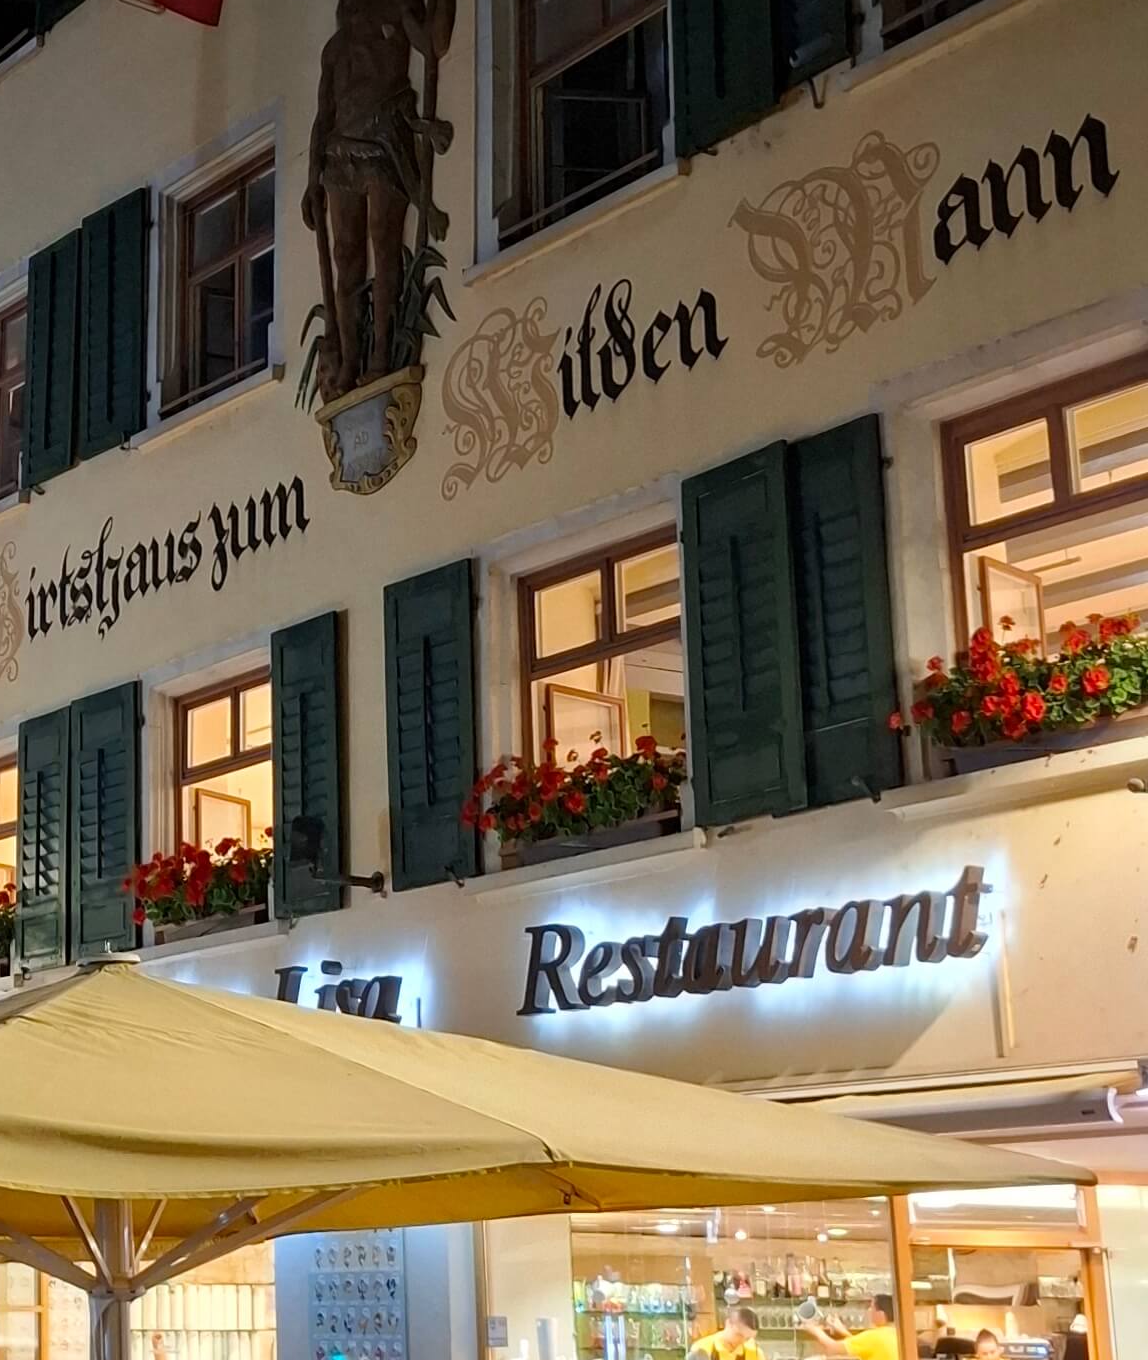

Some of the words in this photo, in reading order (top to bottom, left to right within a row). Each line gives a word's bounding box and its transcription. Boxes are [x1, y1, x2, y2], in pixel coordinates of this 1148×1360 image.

[207, 474, 311, 592] zum
[441, 278, 729, 502] Wilden
[726, 113, 1120, 370] Mann
[515, 864, 994, 1016] Restaurant
